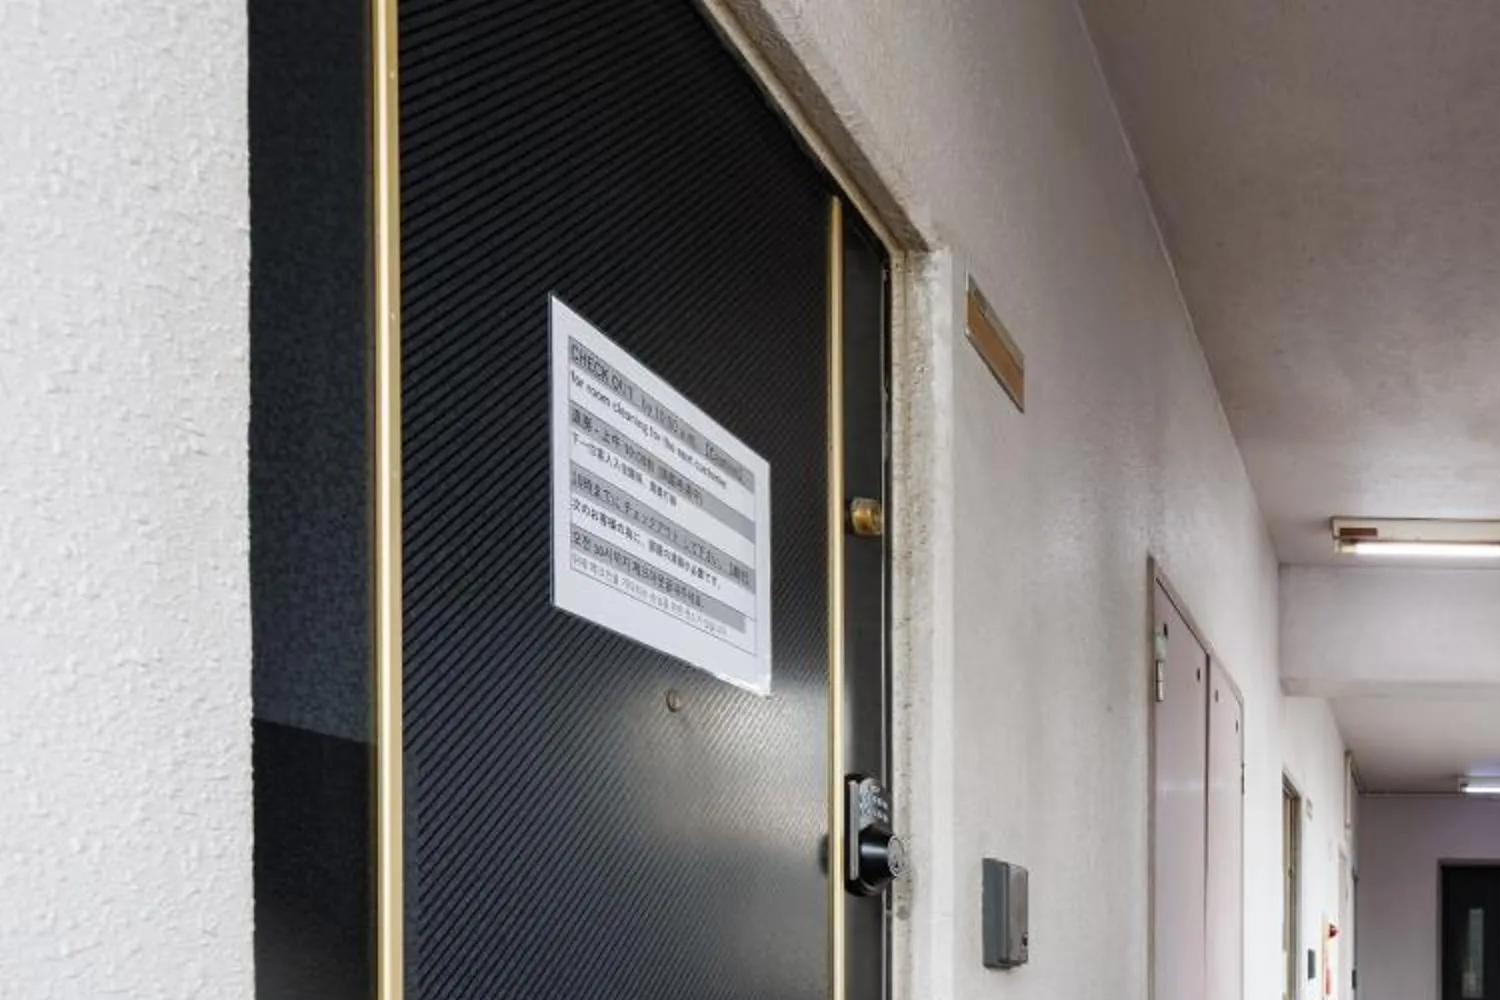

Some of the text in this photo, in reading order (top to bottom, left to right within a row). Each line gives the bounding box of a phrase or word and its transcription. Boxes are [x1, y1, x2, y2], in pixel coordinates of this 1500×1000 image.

[571, 343, 608, 384] CHECK
[611, 373, 632, 401] OUT
[587, 383, 610, 407] room
